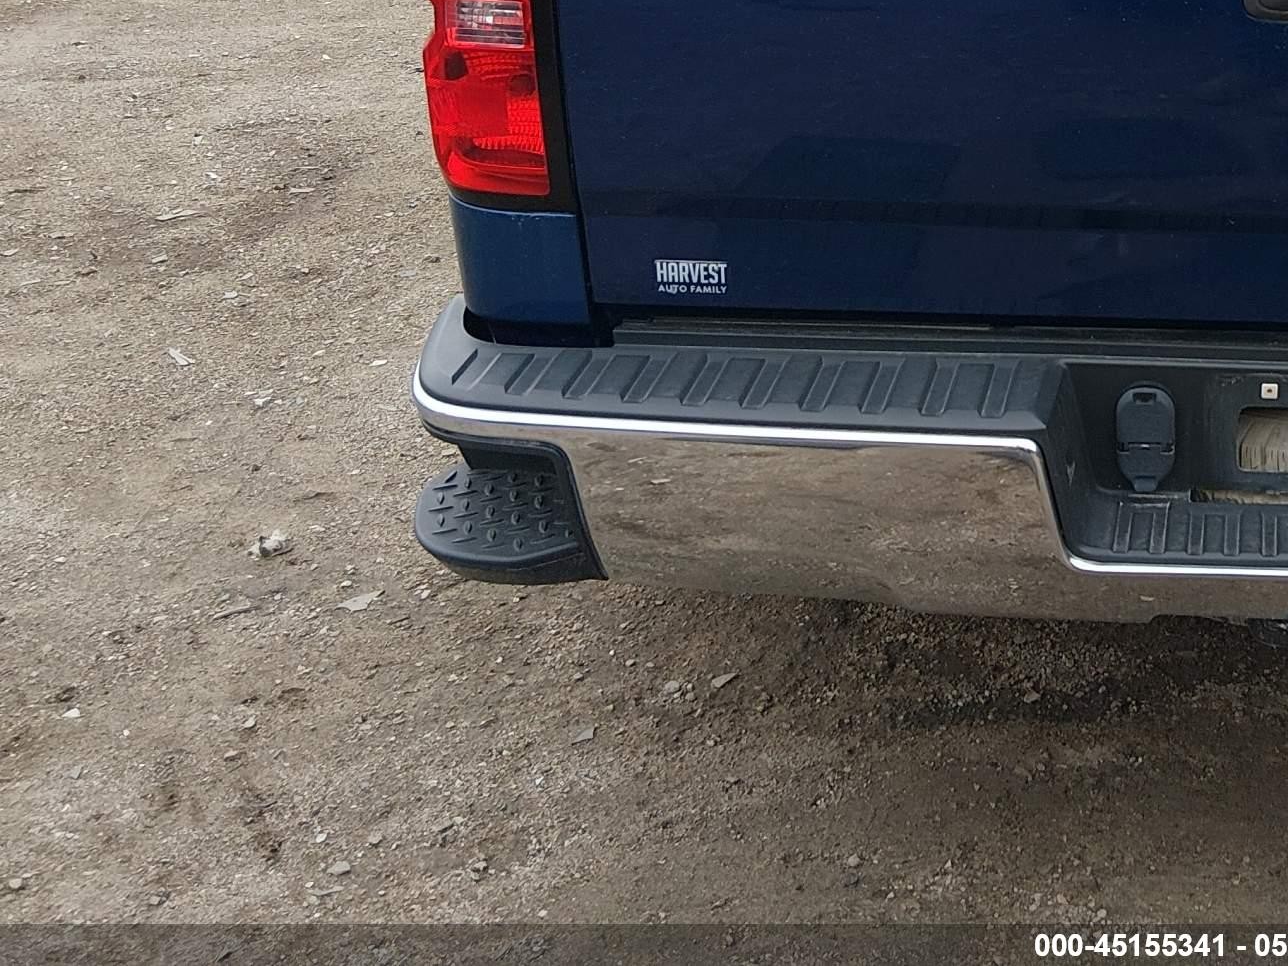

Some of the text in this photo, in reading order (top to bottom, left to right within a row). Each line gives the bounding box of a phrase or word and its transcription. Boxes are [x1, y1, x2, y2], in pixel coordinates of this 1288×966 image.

[655, 261, 728, 284] HARVEST
[658, 284, 728, 294] AUTO FAMILY
